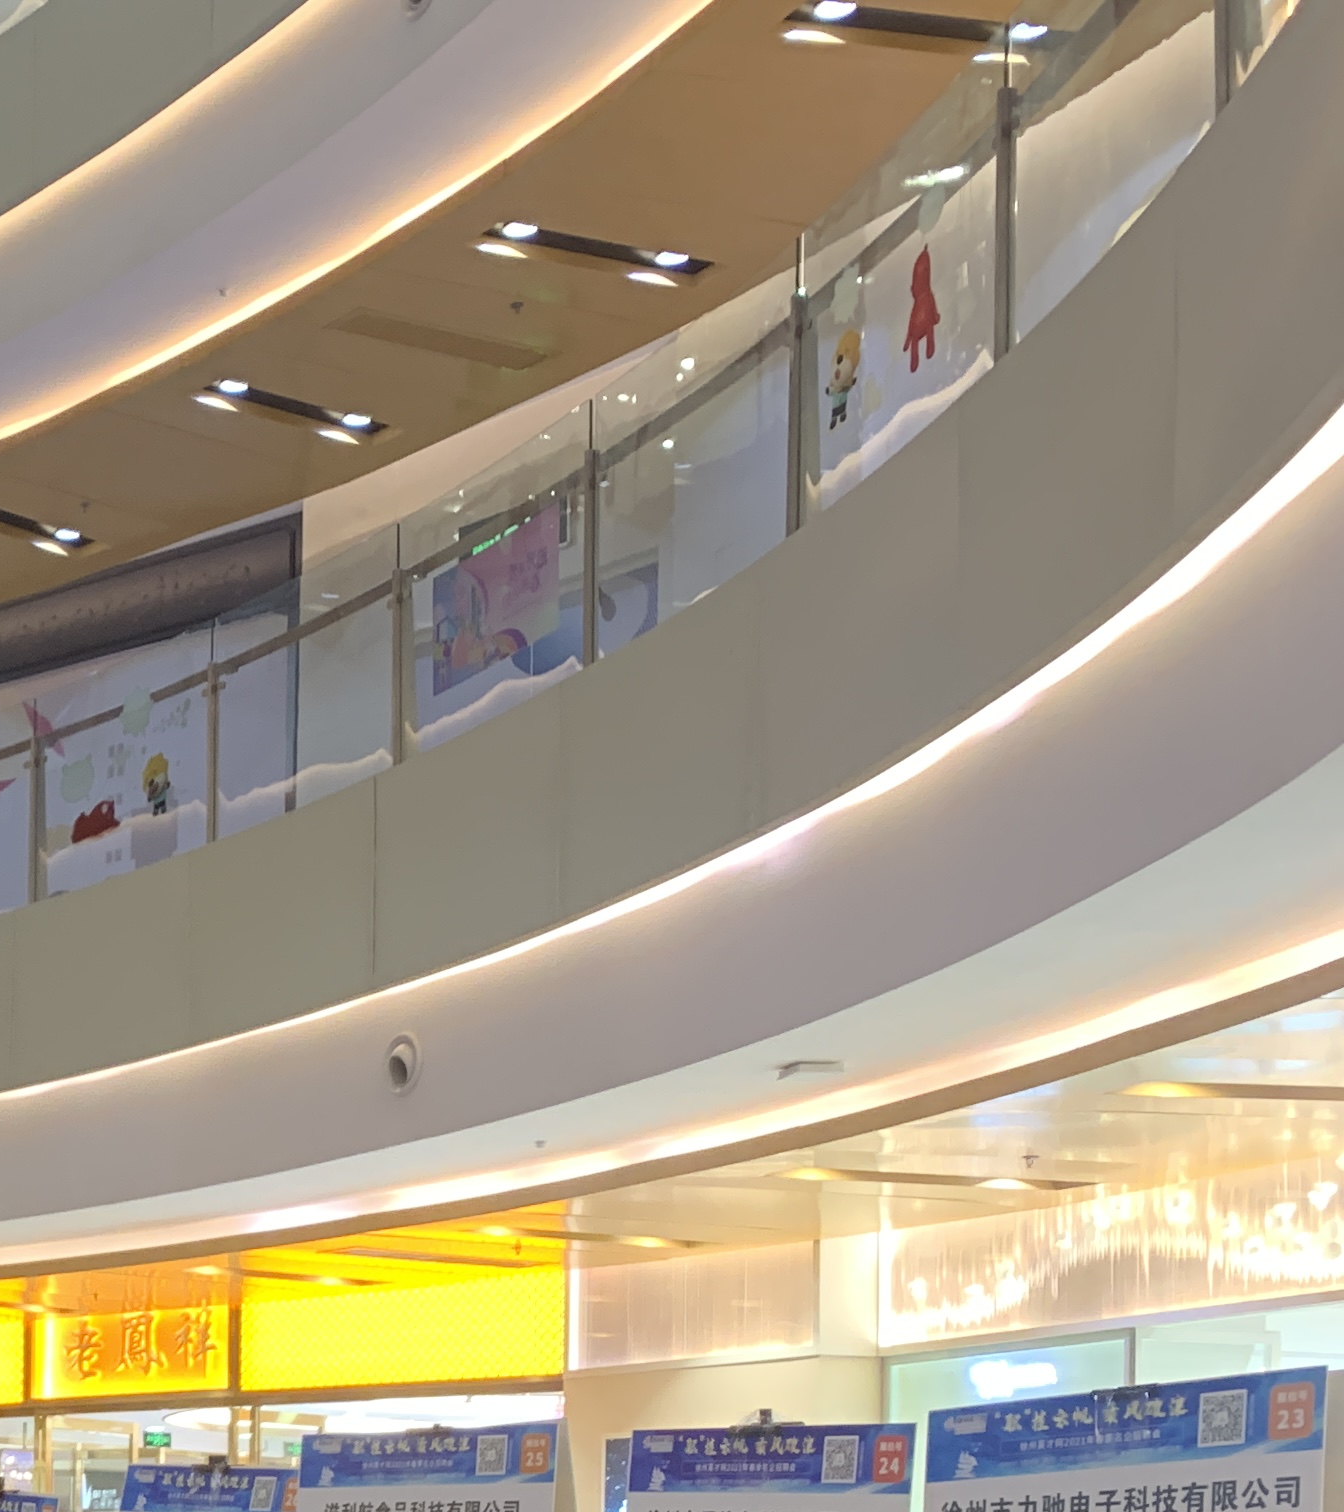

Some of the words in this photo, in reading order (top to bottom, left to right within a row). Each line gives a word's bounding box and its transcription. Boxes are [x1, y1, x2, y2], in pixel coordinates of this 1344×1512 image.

[1277, 1407, 1307, 1431] 23
[525, 1450, 545, 1468] 25
[878, 1456, 900, 1475] 24
